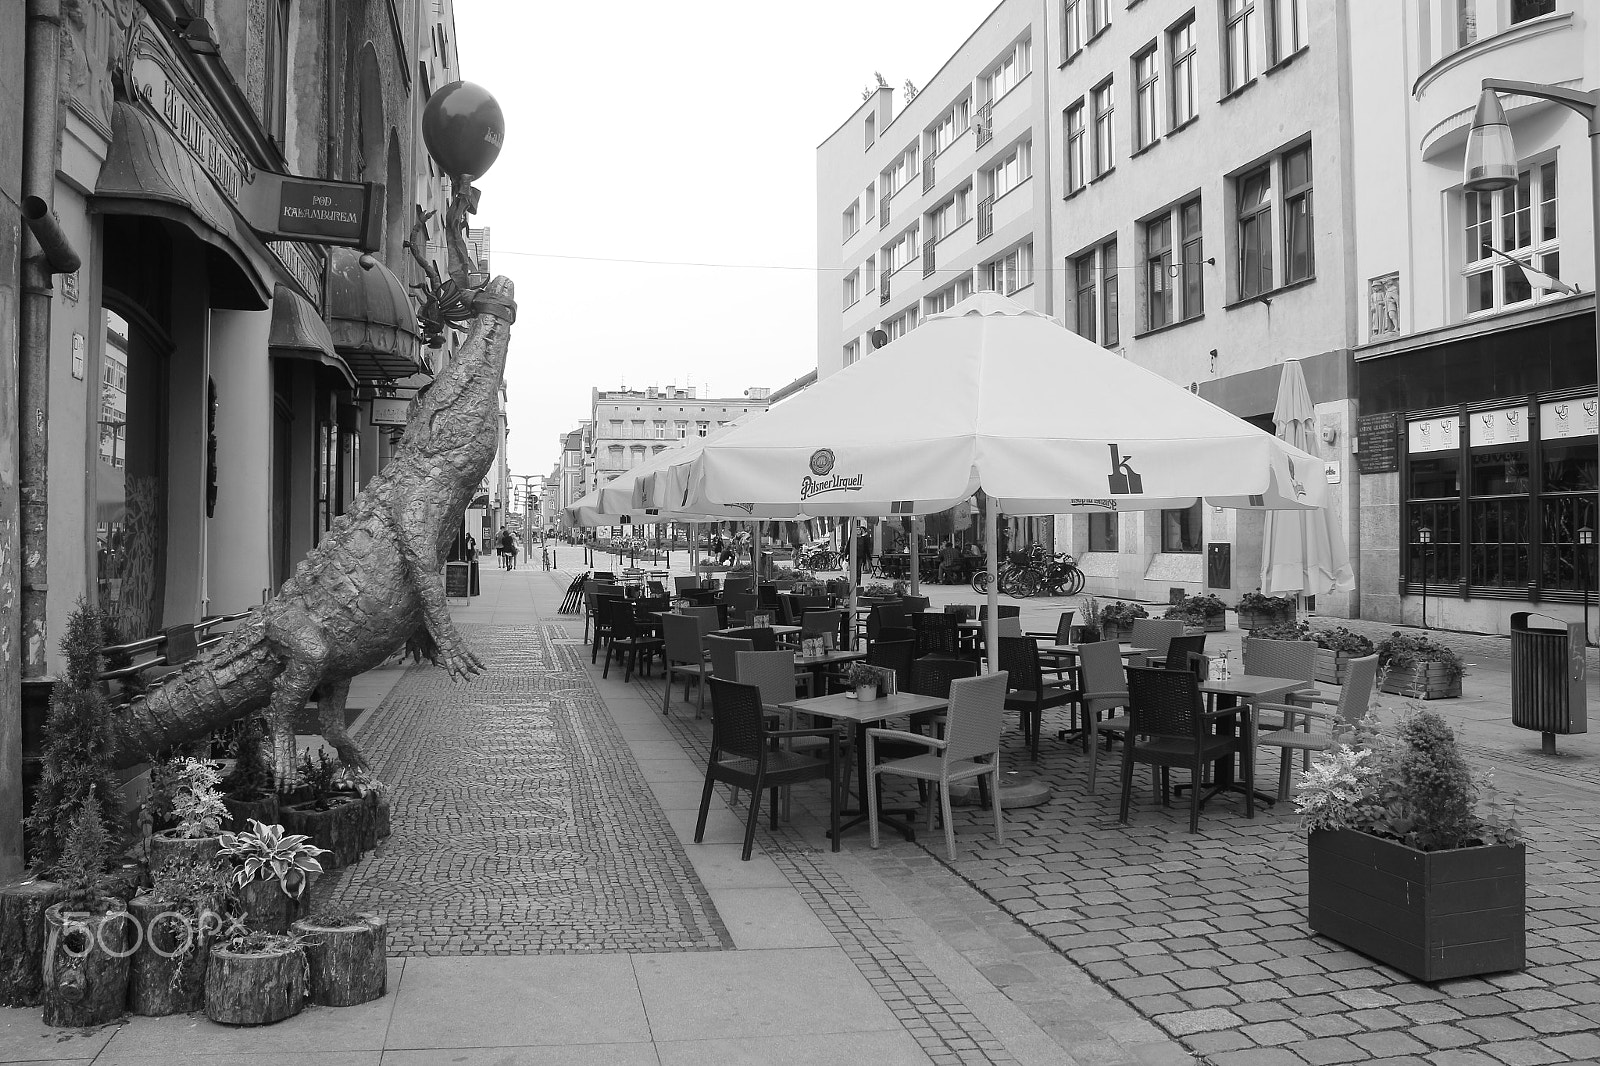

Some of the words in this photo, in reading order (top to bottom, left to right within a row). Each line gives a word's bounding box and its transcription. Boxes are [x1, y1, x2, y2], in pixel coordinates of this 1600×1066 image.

[312, 196, 332, 206] POD
[800, 475, 833, 501] Pilsner
[832, 473, 863, 492] Urquell
